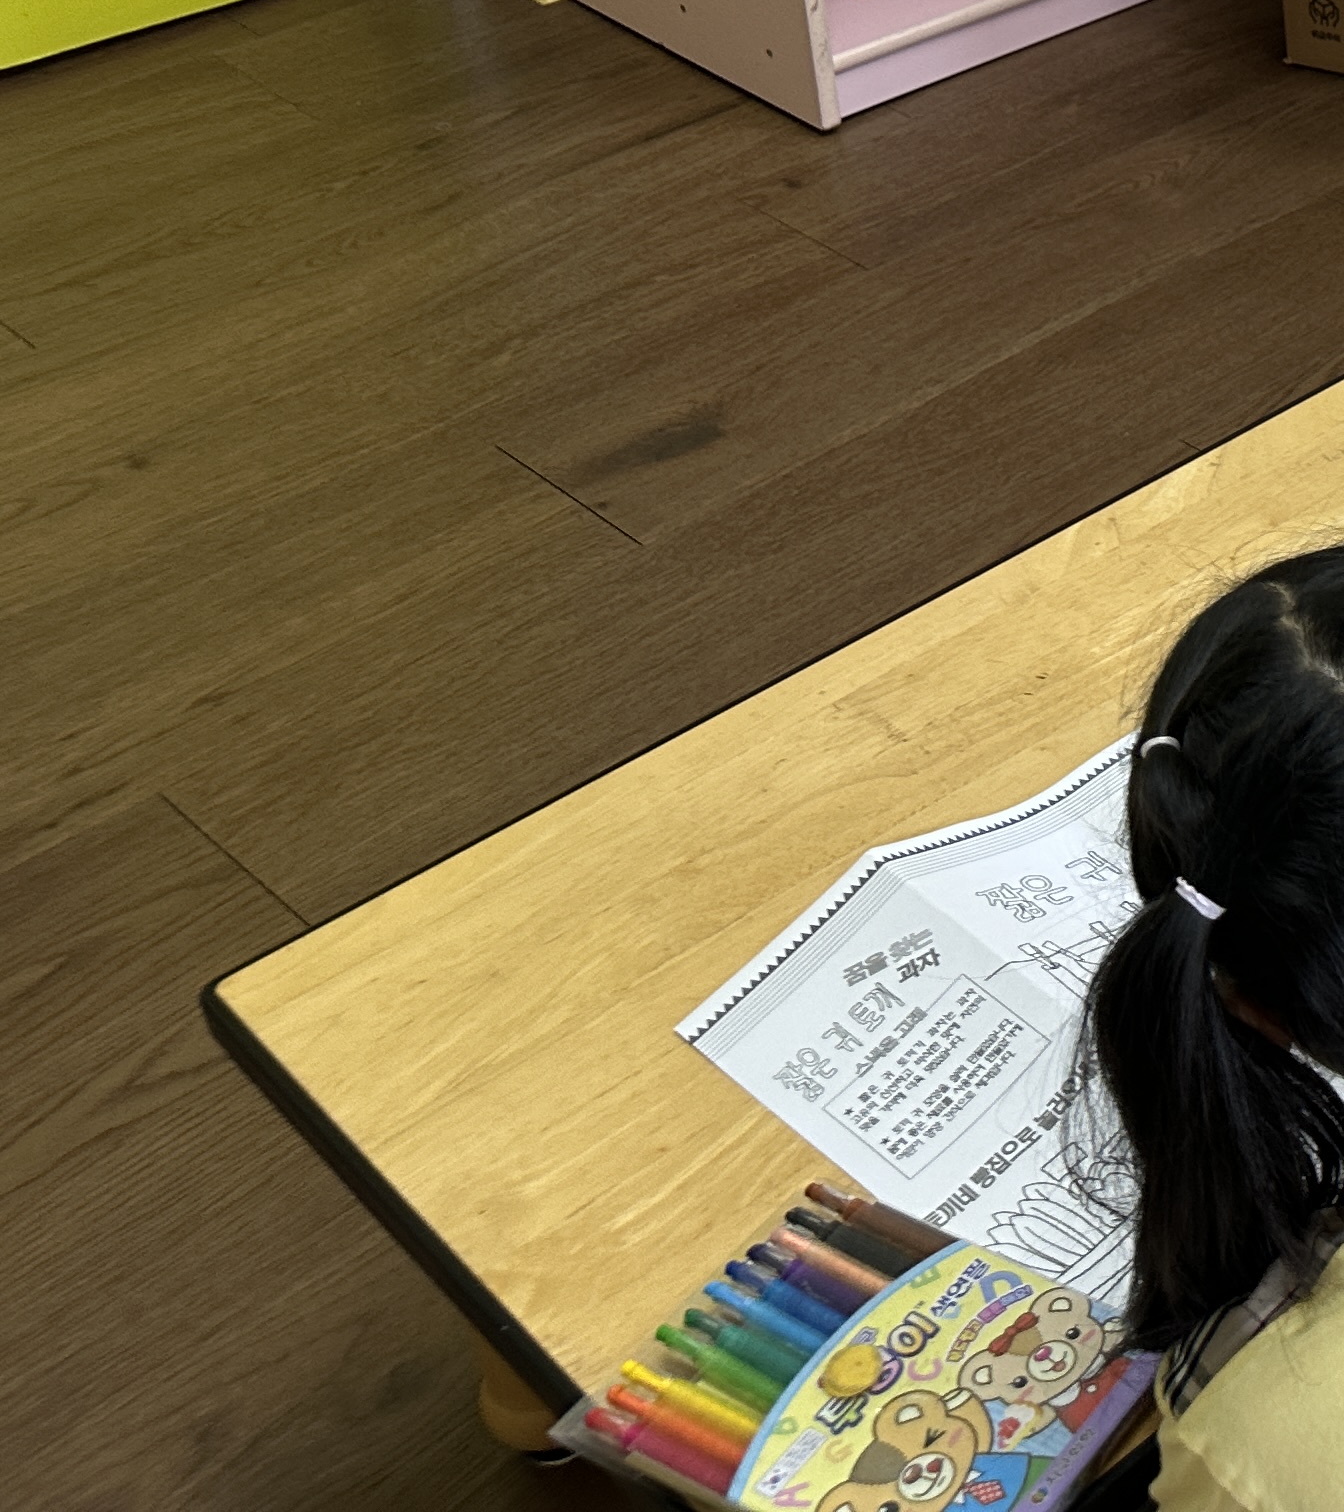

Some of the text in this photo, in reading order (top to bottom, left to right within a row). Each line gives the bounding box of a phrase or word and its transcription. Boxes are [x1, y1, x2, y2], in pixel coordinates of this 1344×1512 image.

[975, 850, 1123, 924] 짧은 귀
[844, 952, 887, 984] 꿈을
[897, 949, 938, 982] 과자
[773, 982, 904, 1102] 짧은 귀 토끼
[971, 1127, 1040, 1188] 빵집으로
[930, 1257, 991, 1318] 색연필
